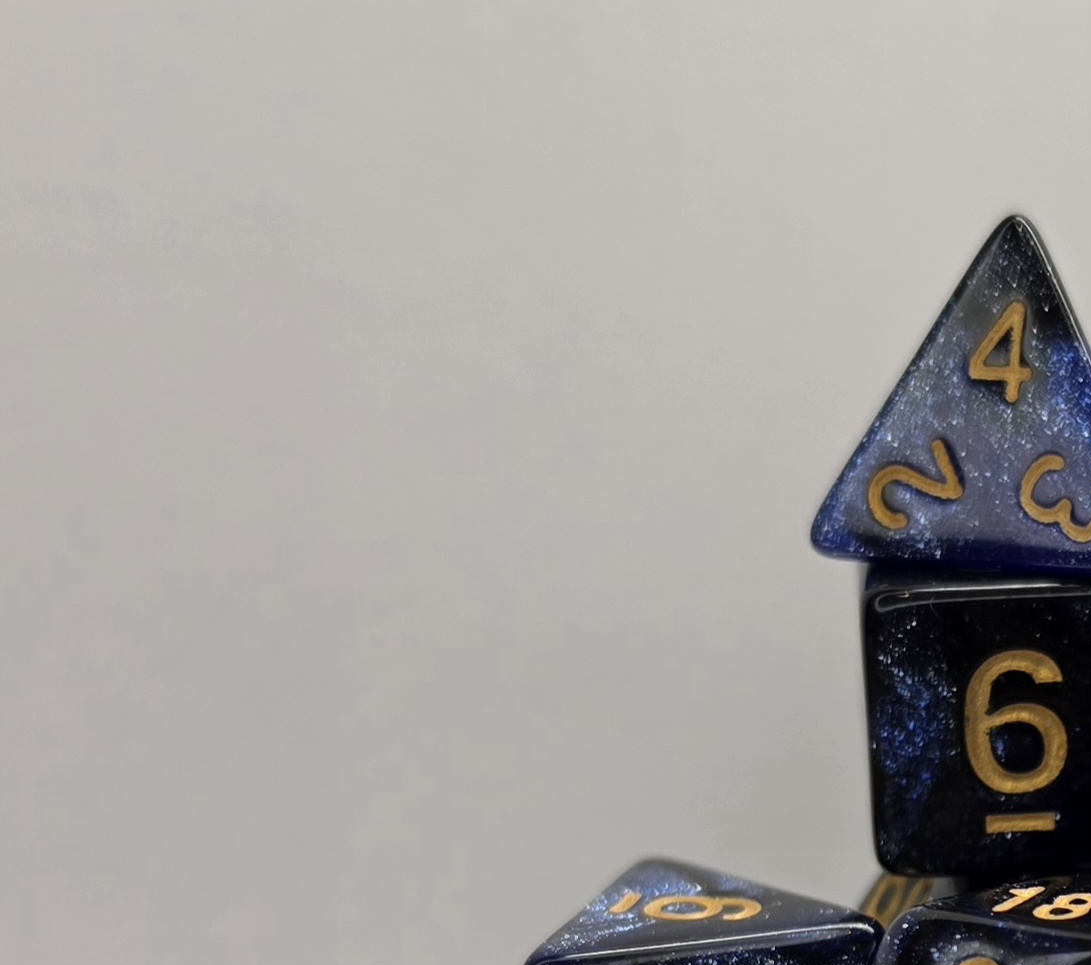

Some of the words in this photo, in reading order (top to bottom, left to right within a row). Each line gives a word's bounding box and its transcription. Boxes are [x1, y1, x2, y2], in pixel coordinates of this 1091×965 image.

[968, 300, 1033, 404] 4
[867, 438, 963, 530] 2
[964, 650, 1069, 795] 6
